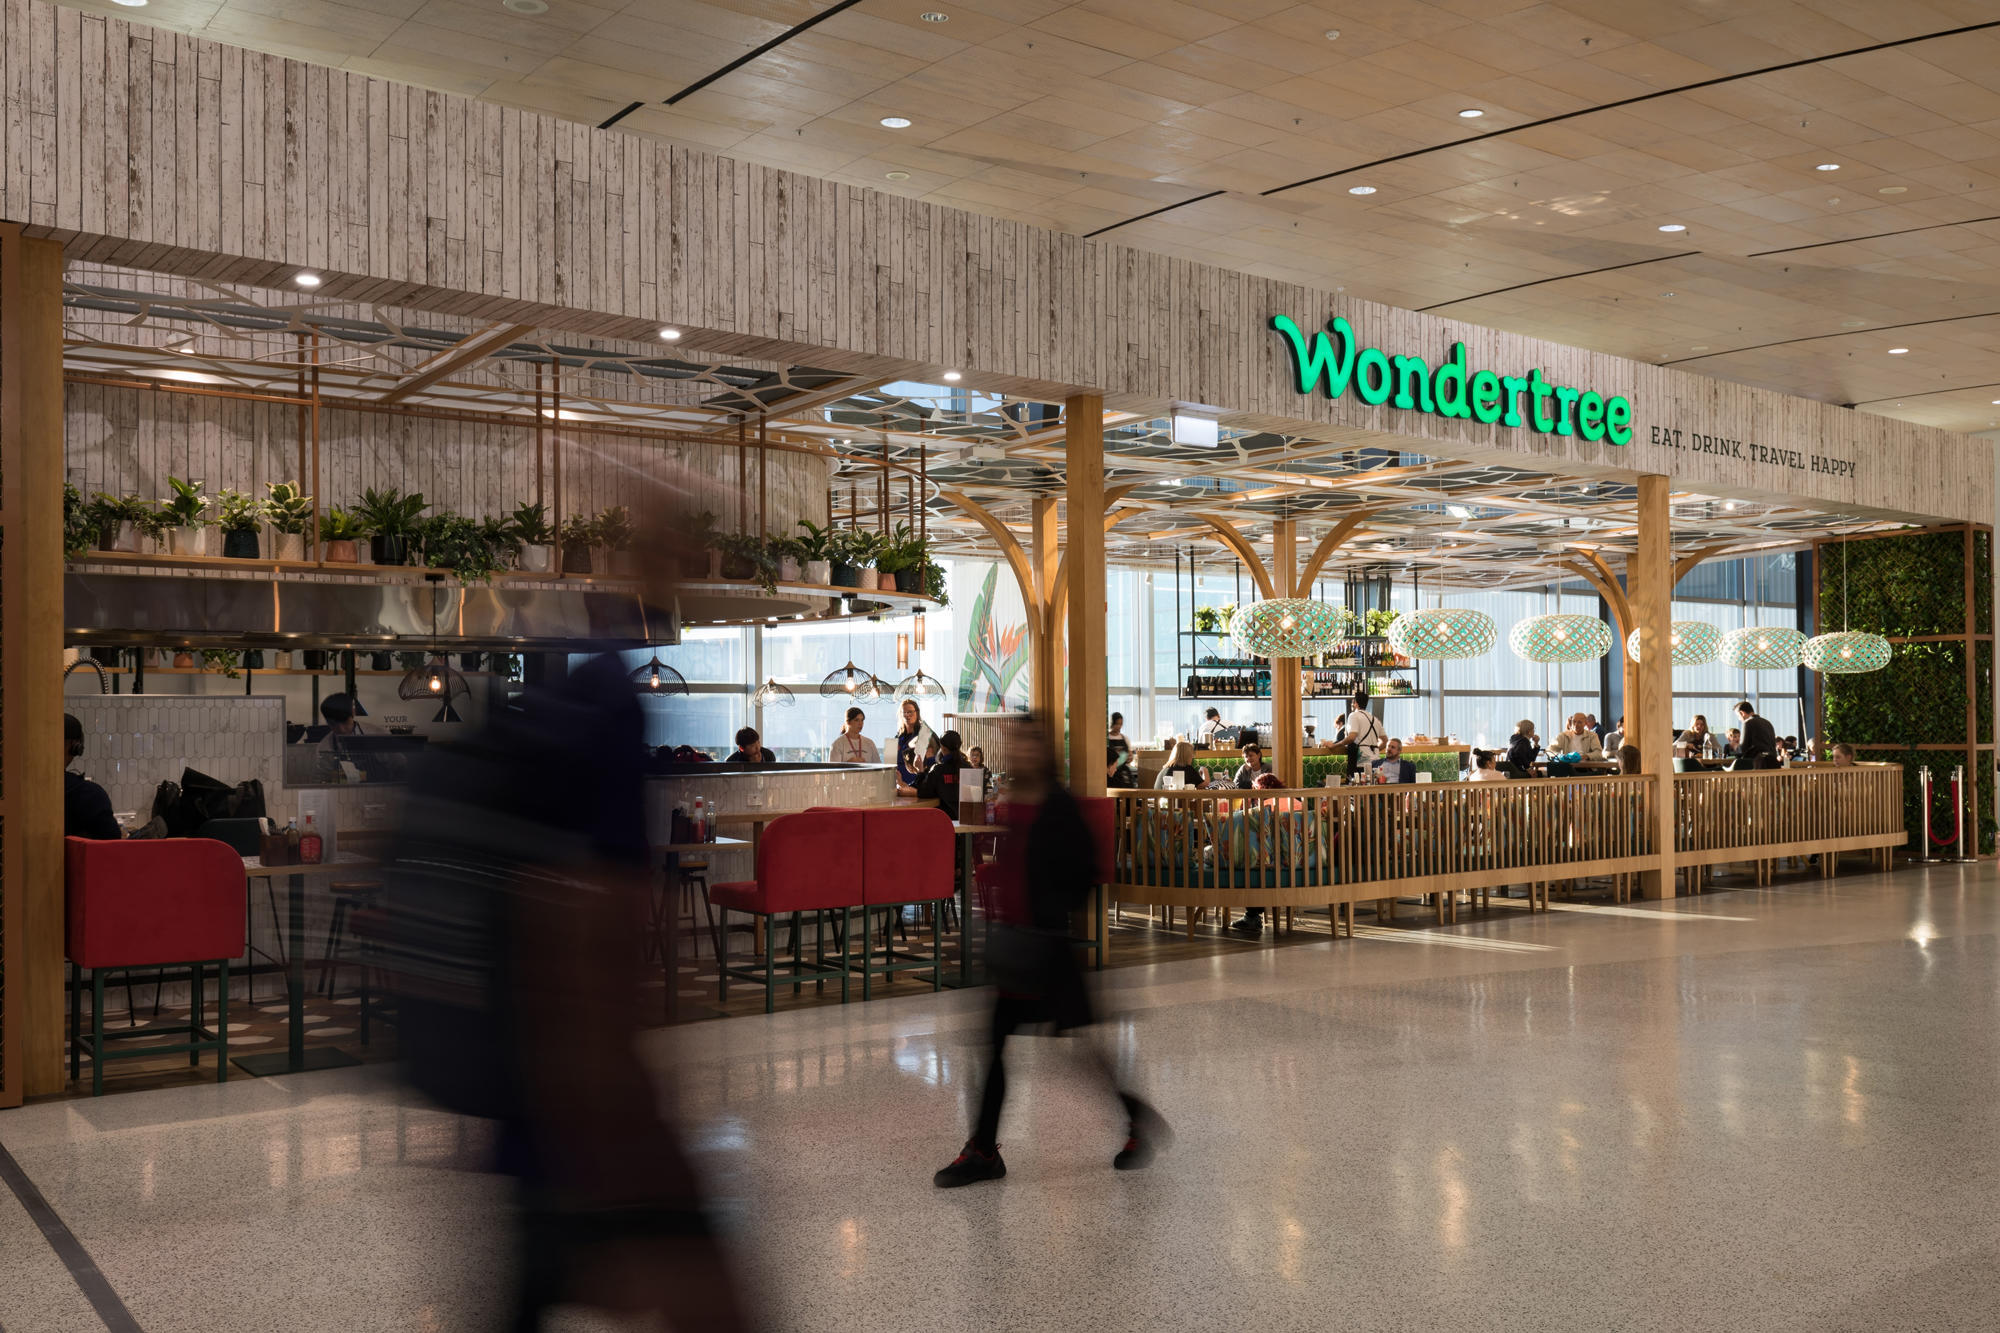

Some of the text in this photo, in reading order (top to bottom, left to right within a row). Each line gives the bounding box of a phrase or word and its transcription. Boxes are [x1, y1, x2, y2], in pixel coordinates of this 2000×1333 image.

[1271, 315, 1632, 445] Wondertree
[1651, 426, 1856, 478] EAT, DRINK, TRAVEL HAPPY
[384, 715, 408, 723] YOUR
